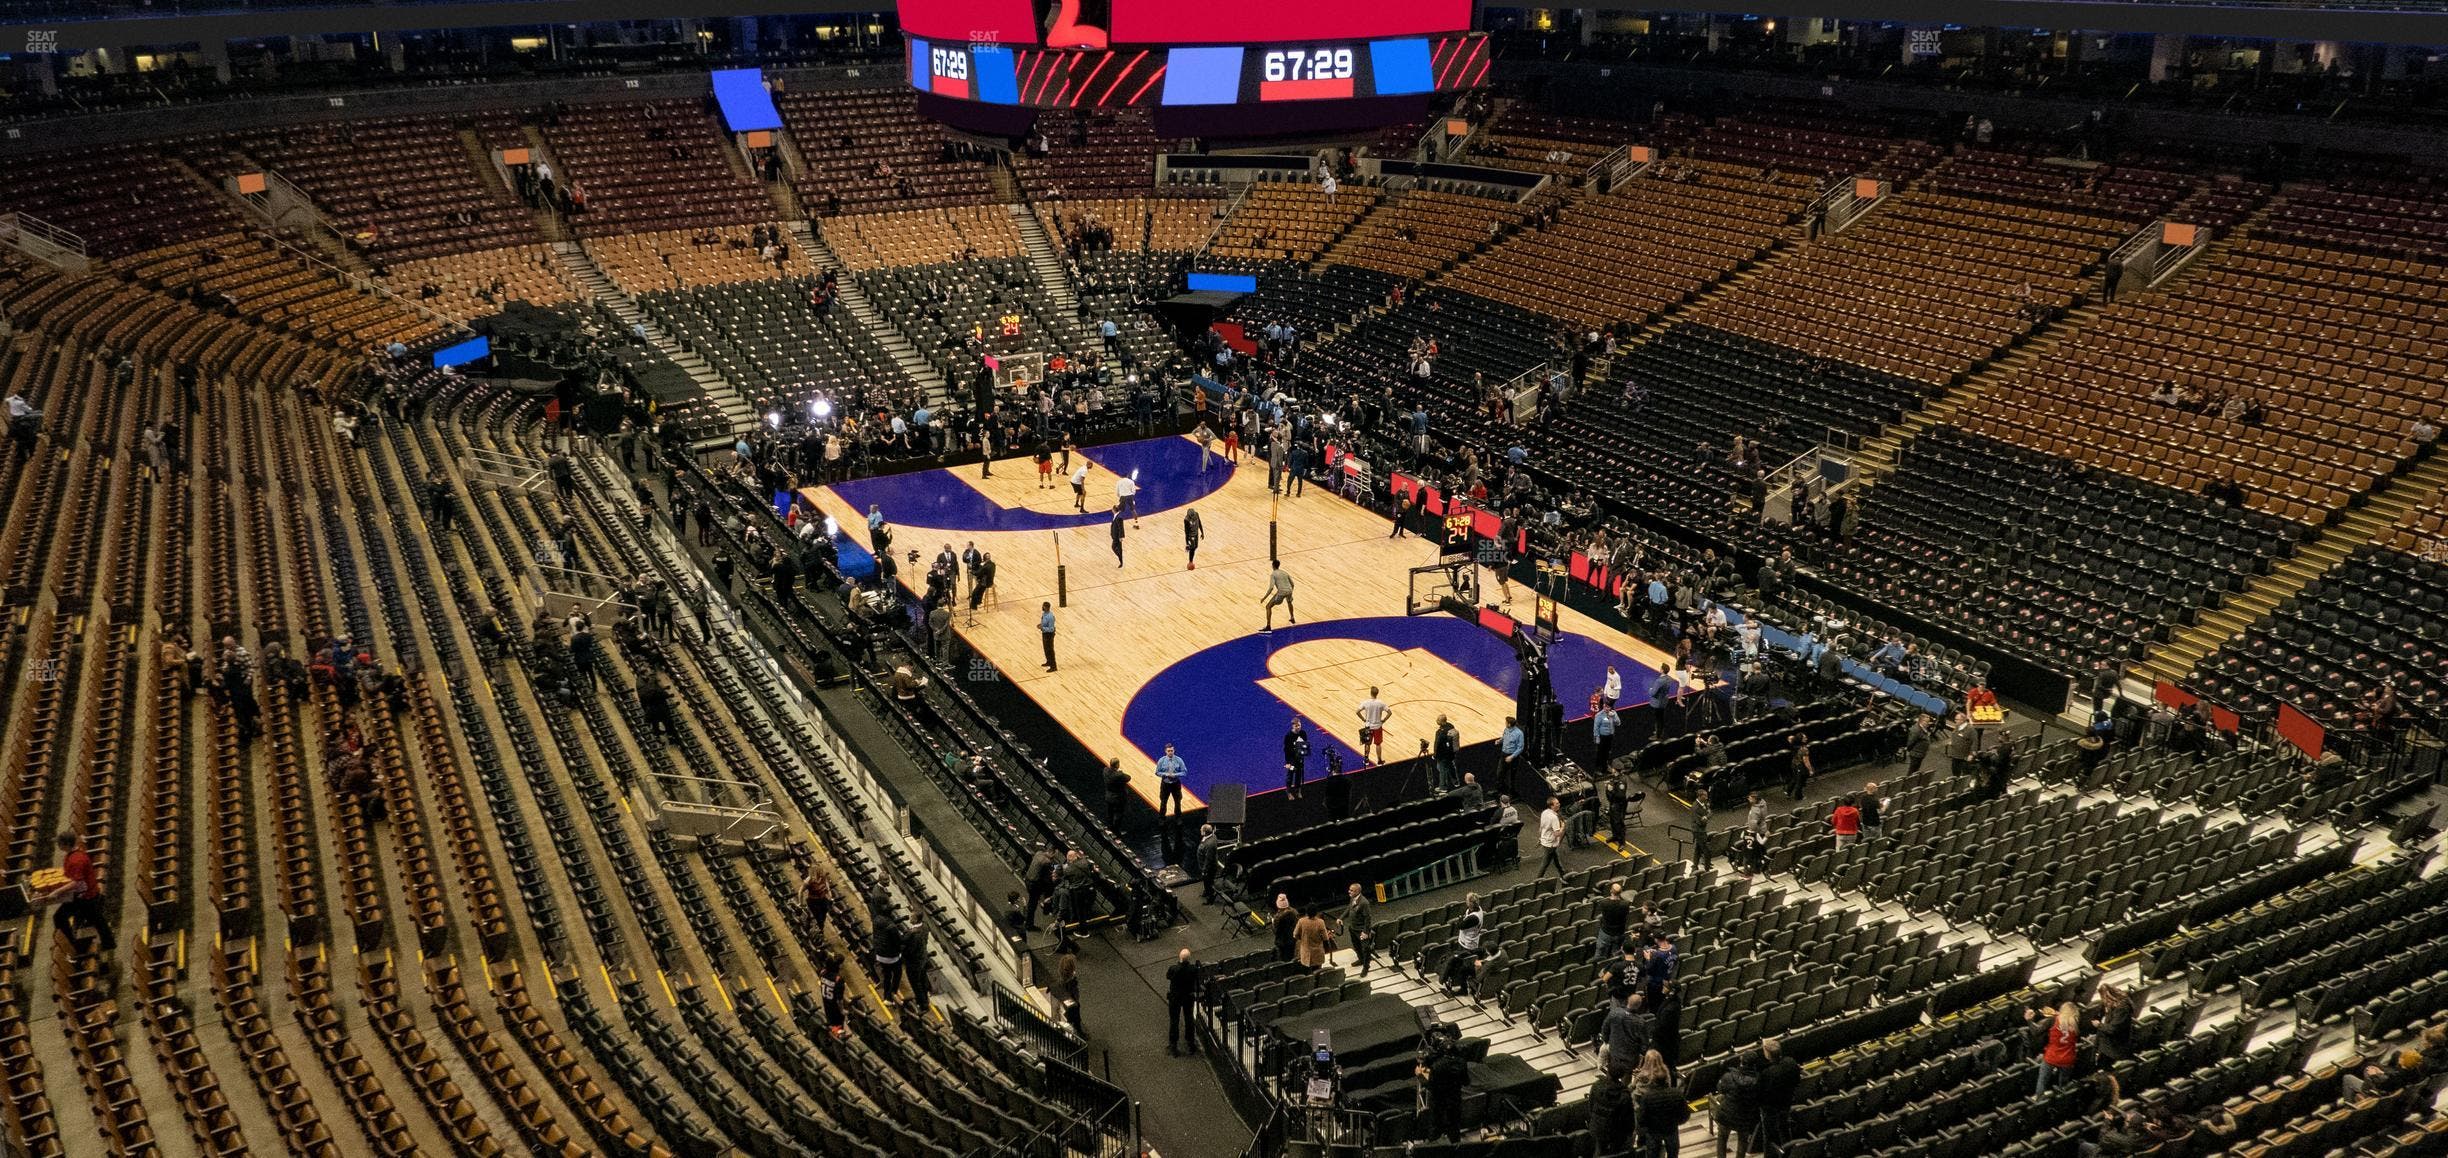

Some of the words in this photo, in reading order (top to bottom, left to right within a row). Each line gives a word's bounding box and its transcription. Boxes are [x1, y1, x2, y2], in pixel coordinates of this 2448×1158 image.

[933, 48, 968, 80] 67:29
[1264, 49, 1353, 82] 67:29
[847, 69, 860, 78] 114
[625, 80, 640, 88] 113
[329, 98, 344, 107] 112
[8, 129, 21, 139] 111
[1003, 323, 1018, 335] 24
[1446, 516, 1470, 528] 67:28
[1448, 527, 1468, 544] 24
[1746, 839, 1753, 849] 2
[1623, 972, 1637, 985] 23
[821, 984, 834, 1000] 15
[2060, 1030, 2069, 1044] 2
